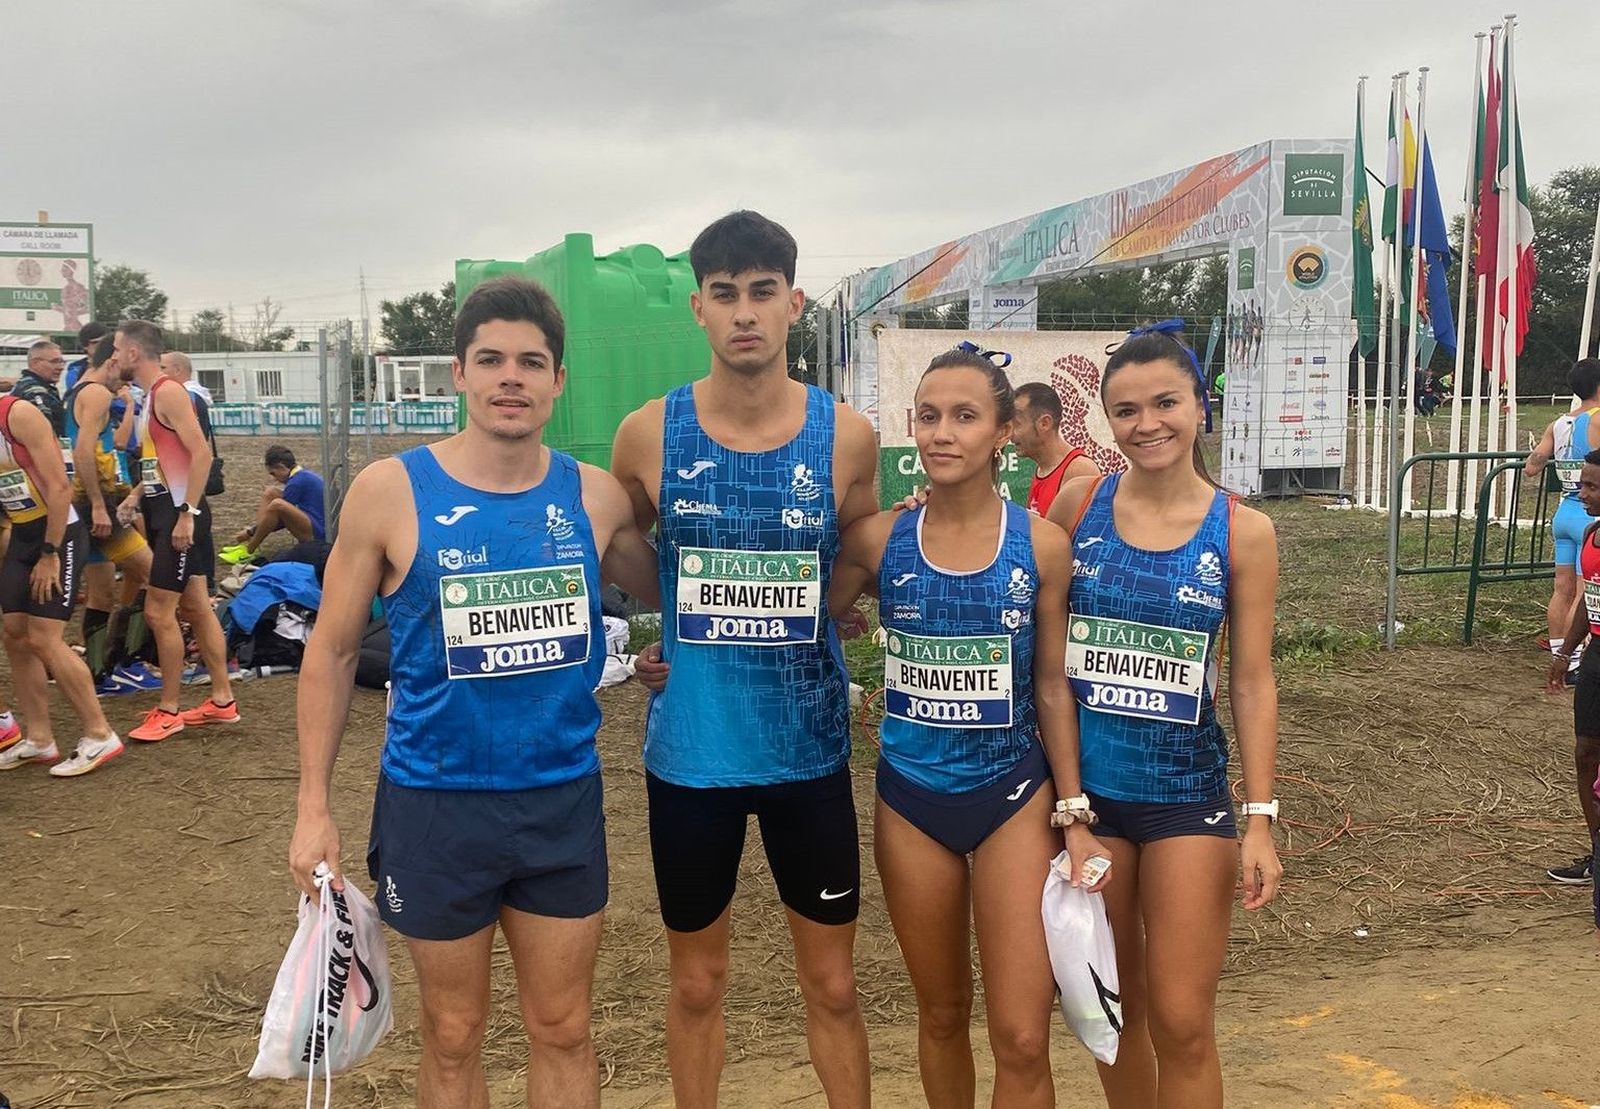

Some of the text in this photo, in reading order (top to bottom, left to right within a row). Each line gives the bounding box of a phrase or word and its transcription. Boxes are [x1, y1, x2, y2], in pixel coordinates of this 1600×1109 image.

[1291, 190, 1335, 198] SEVILLA
[1191, 221, 1212, 240] POR
[1213, 210, 1250, 236] CLUBES
[710, 554, 792, 577] ITÁLICA
[475, 577, 559, 601] ITÁLICA
[700, 583, 807, 609] BENAVENTE
[679, 602, 693, 612] 124
[812, 606, 817, 615] 1
[468, 602, 577, 637] BENAVENTE
[583, 622, 589, 633] 3
[447, 634, 463, 646] 124
[1094, 625, 1176, 652] ITÁLICA
[905, 640, 982, 661] ITÁLICA
[901, 664, 998, 691] BENAVENTE
[1066, 666, 1078, 677] 124
[1084, 650, 1190, 686] BENAVENTE
[886, 678, 897, 688] 124
[1194, 686, 1200, 695] 4
[1004, 689, 1010, 699] 2
[331, 892, 352, 926] FIE
[336, 929, 353, 949] &
